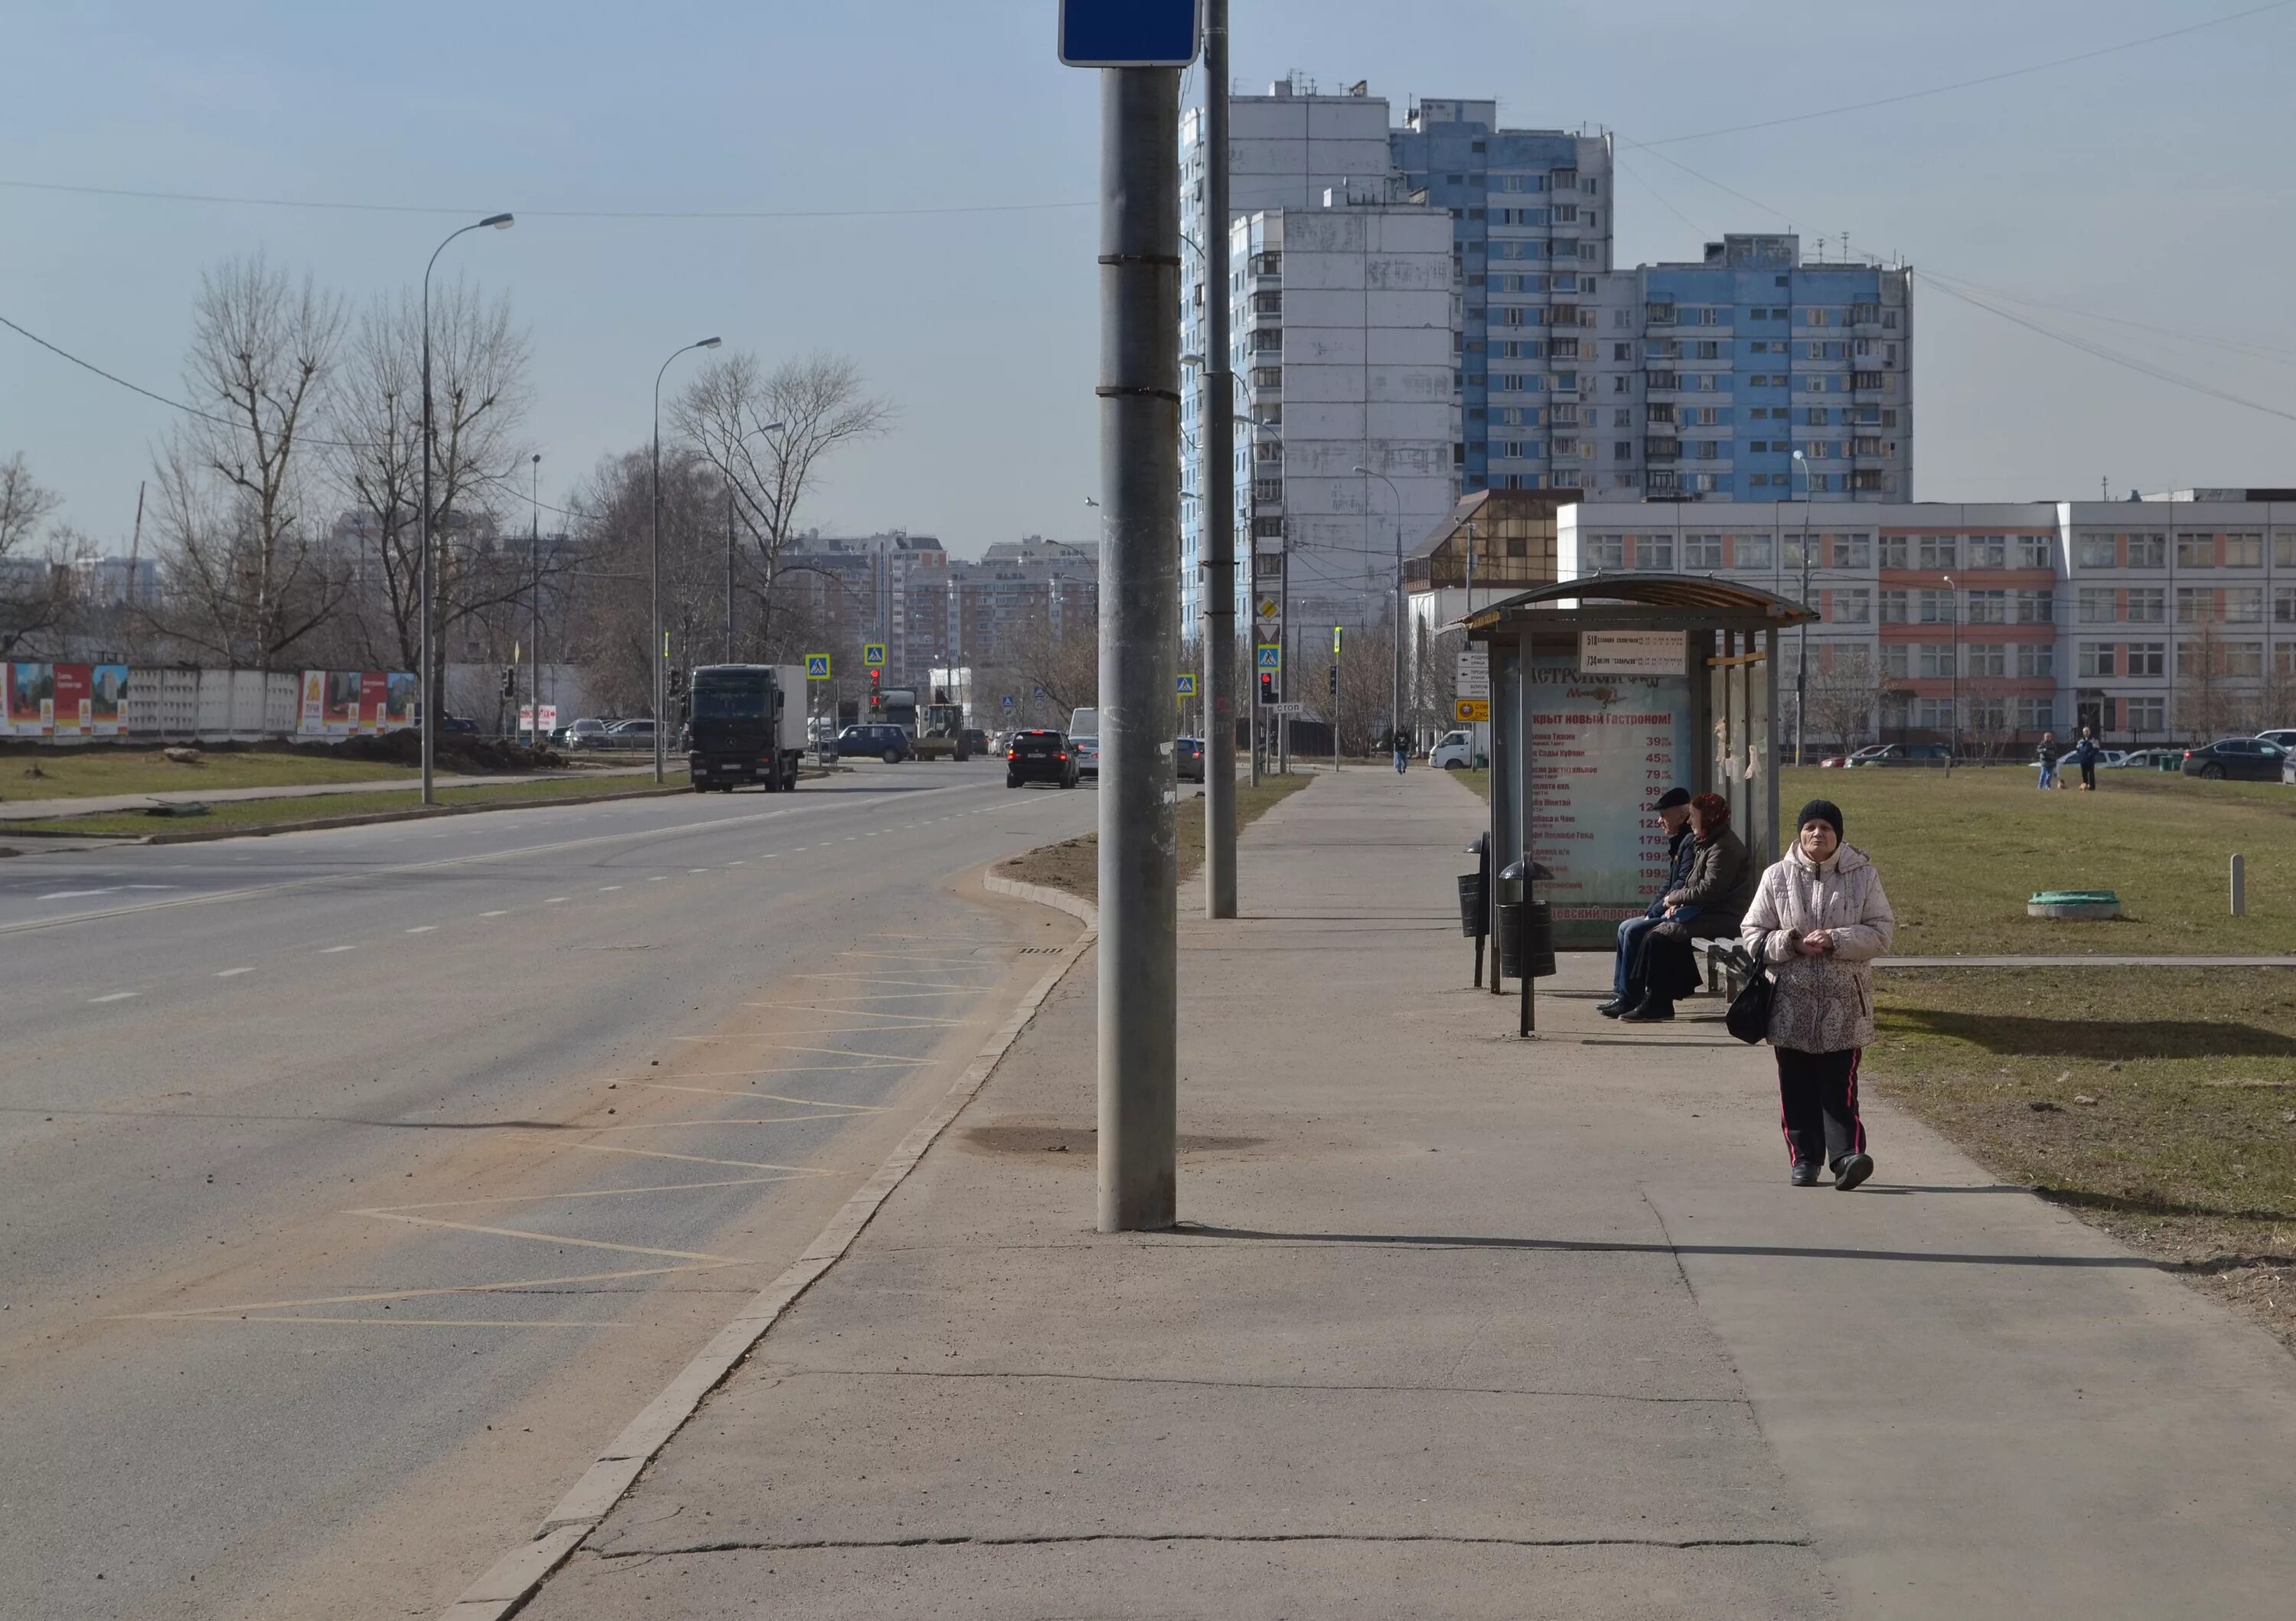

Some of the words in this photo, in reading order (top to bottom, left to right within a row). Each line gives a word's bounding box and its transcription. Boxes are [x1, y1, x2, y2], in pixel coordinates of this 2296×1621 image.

[1587, 635, 1597, 646] 518
[1587, 655, 1596, 666] 734
[1532, 715, 1562, 725] крыт
[1565, 713, 1603, 725] новый
[1606, 713, 1671, 726] Гастроном!
[1646, 737, 1661, 746] 39
[1645, 753, 1661, 762] 45
[1646, 770, 1661, 779] 79
[1645, 786, 1661, 795] 99
[1639, 819, 1661, 828] 125
[1639, 836, 1662, 844] 179
[1639, 852, 1661, 861] 199
[1639, 869, 1661, 878] 199
[1639, 886, 1659, 895] 235
[1551, 906, 1600, 919] цевский
[1603, 908, 1645, 919] проспе
